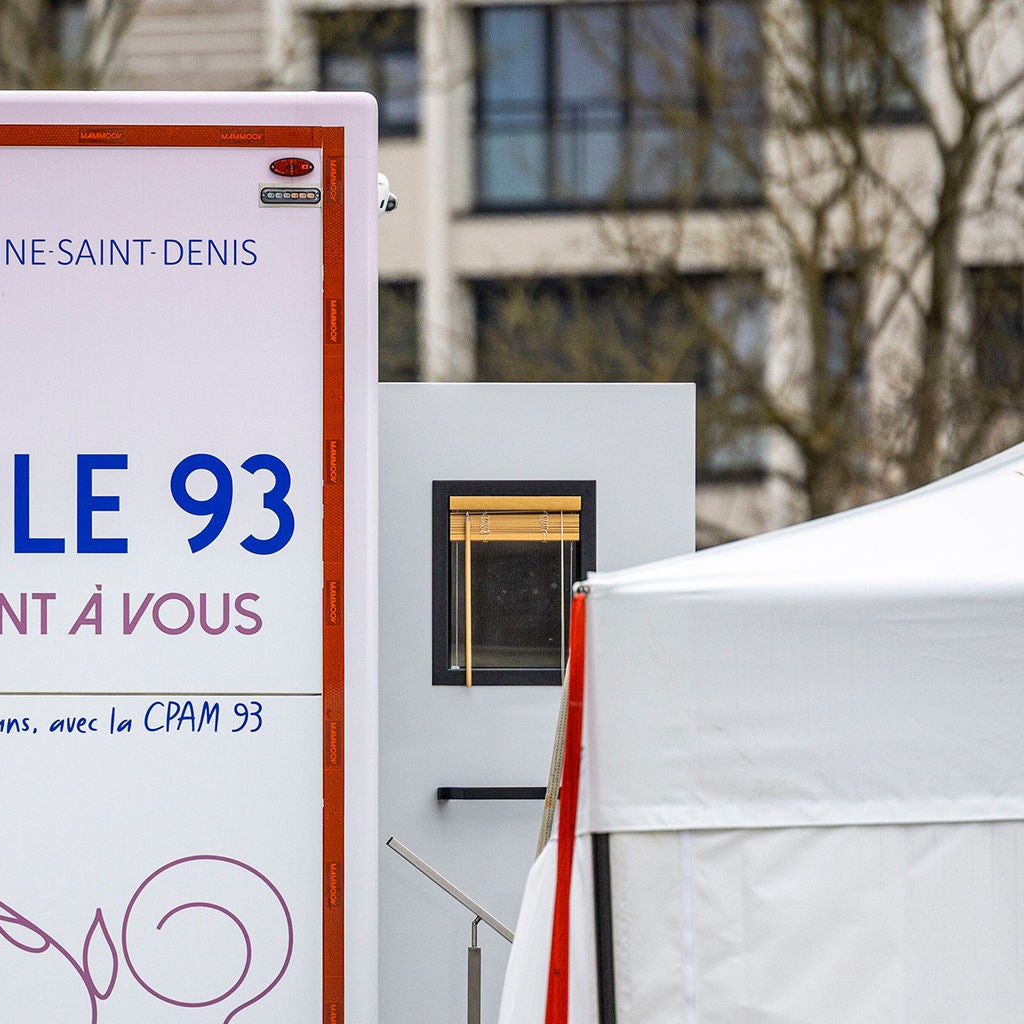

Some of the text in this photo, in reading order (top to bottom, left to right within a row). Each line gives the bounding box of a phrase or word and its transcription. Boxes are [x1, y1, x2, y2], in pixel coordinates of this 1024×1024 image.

[80, 131, 123, 140] MAMMOOV
[220, 132, 264, 140] MAMMOOV
[329, 159, 337, 202] MAMMOOV
[329, 299, 337, 342] MAMMOOV
[329, 440, 337, 483] MAMMOOV
[170, 453, 295, 556] 93
[69, 584, 102, 635] À
[123, 592, 262, 635] VOUS
[329, 581, 337, 624] MAMMOOV
[49, 716, 97, 734] avec
[110, 707, 133, 734] la
[143, 700, 220, 732] CPAM
[232, 701, 263, 733] 93
